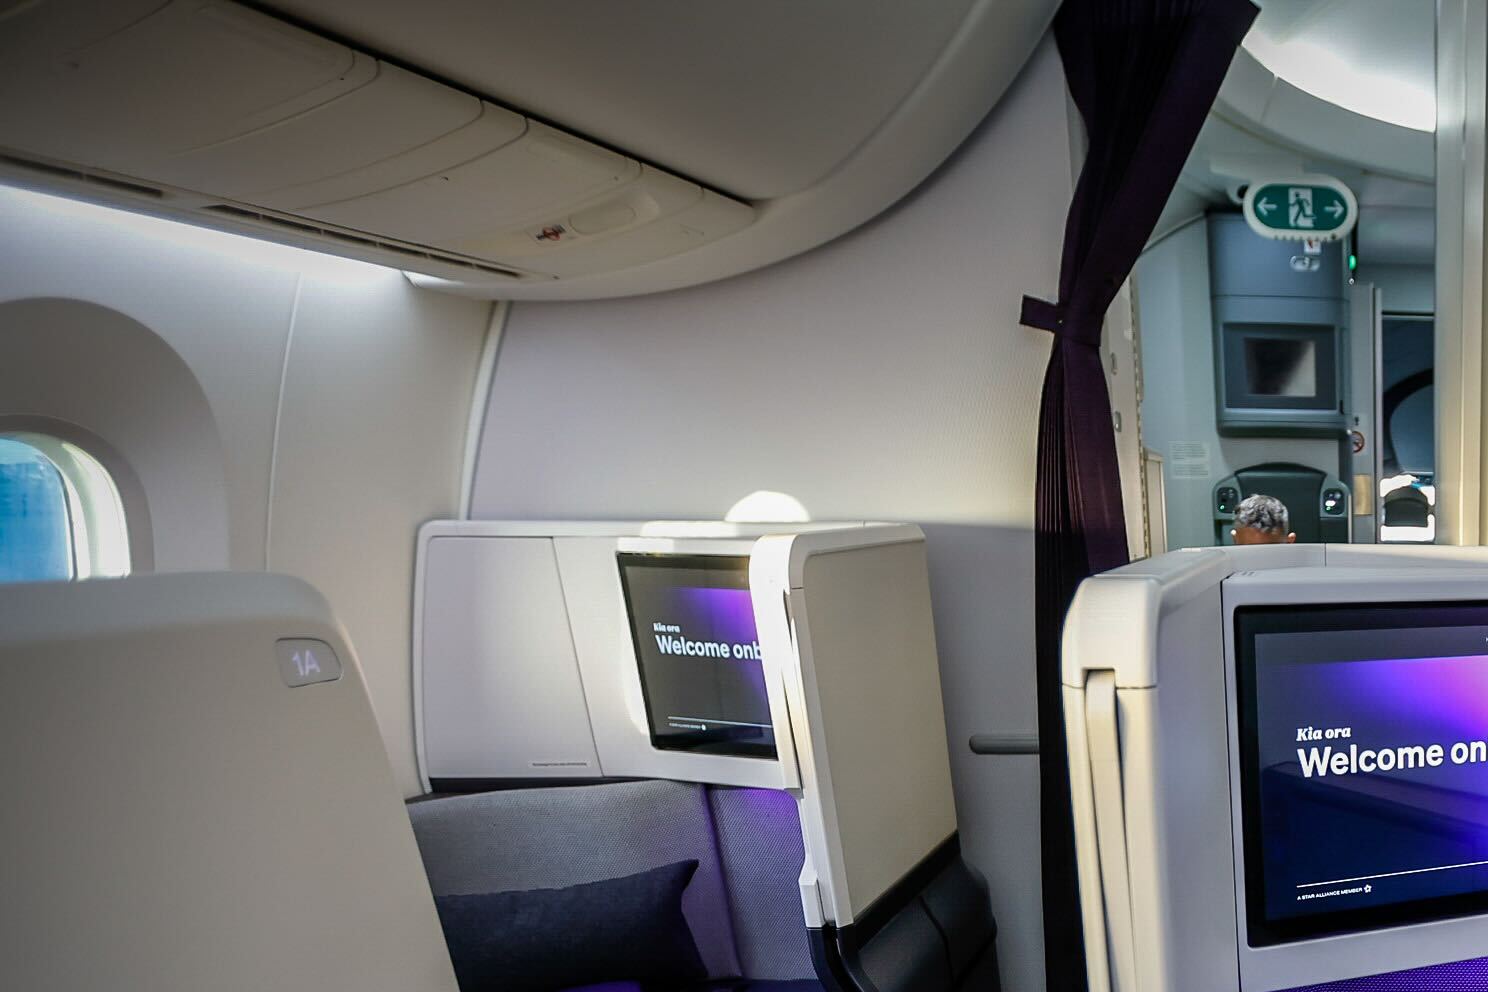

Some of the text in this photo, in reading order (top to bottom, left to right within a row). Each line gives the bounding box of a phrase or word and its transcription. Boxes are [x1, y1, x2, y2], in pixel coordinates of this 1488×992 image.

[655, 634, 731, 658] Welcome
[292, 649, 321, 676] 1A
[1296, 725, 1351, 742] Kia ora
[1297, 744, 1444, 778] Welcome
[1316, 890, 1340, 898] ALLIANCE
[1341, 887, 1363, 895] MEMBER
